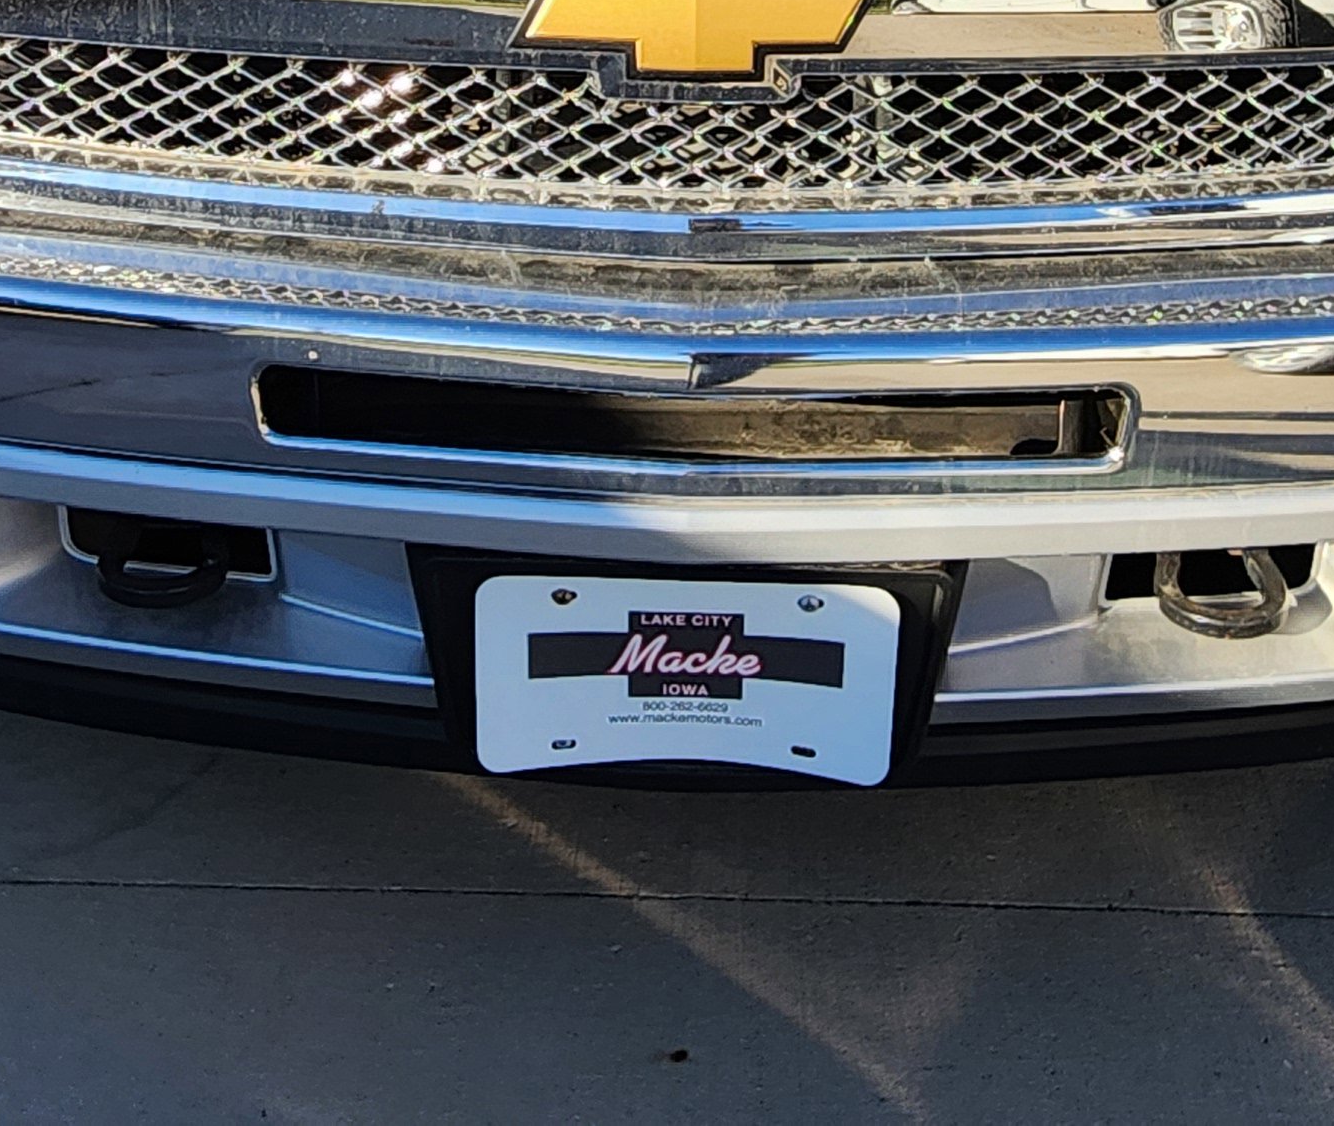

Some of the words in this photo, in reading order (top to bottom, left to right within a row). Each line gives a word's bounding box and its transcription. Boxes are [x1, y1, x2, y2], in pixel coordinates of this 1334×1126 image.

[640, 614, 687, 626] LAKE
[691, 614, 733, 627] CITY
[607, 633, 763, 676] Macke
[662, 683, 709, 696] IOWA
[642, 701, 729, 713] 800-262-6629
[608, 712, 763, 727] www.mackemotors.com
